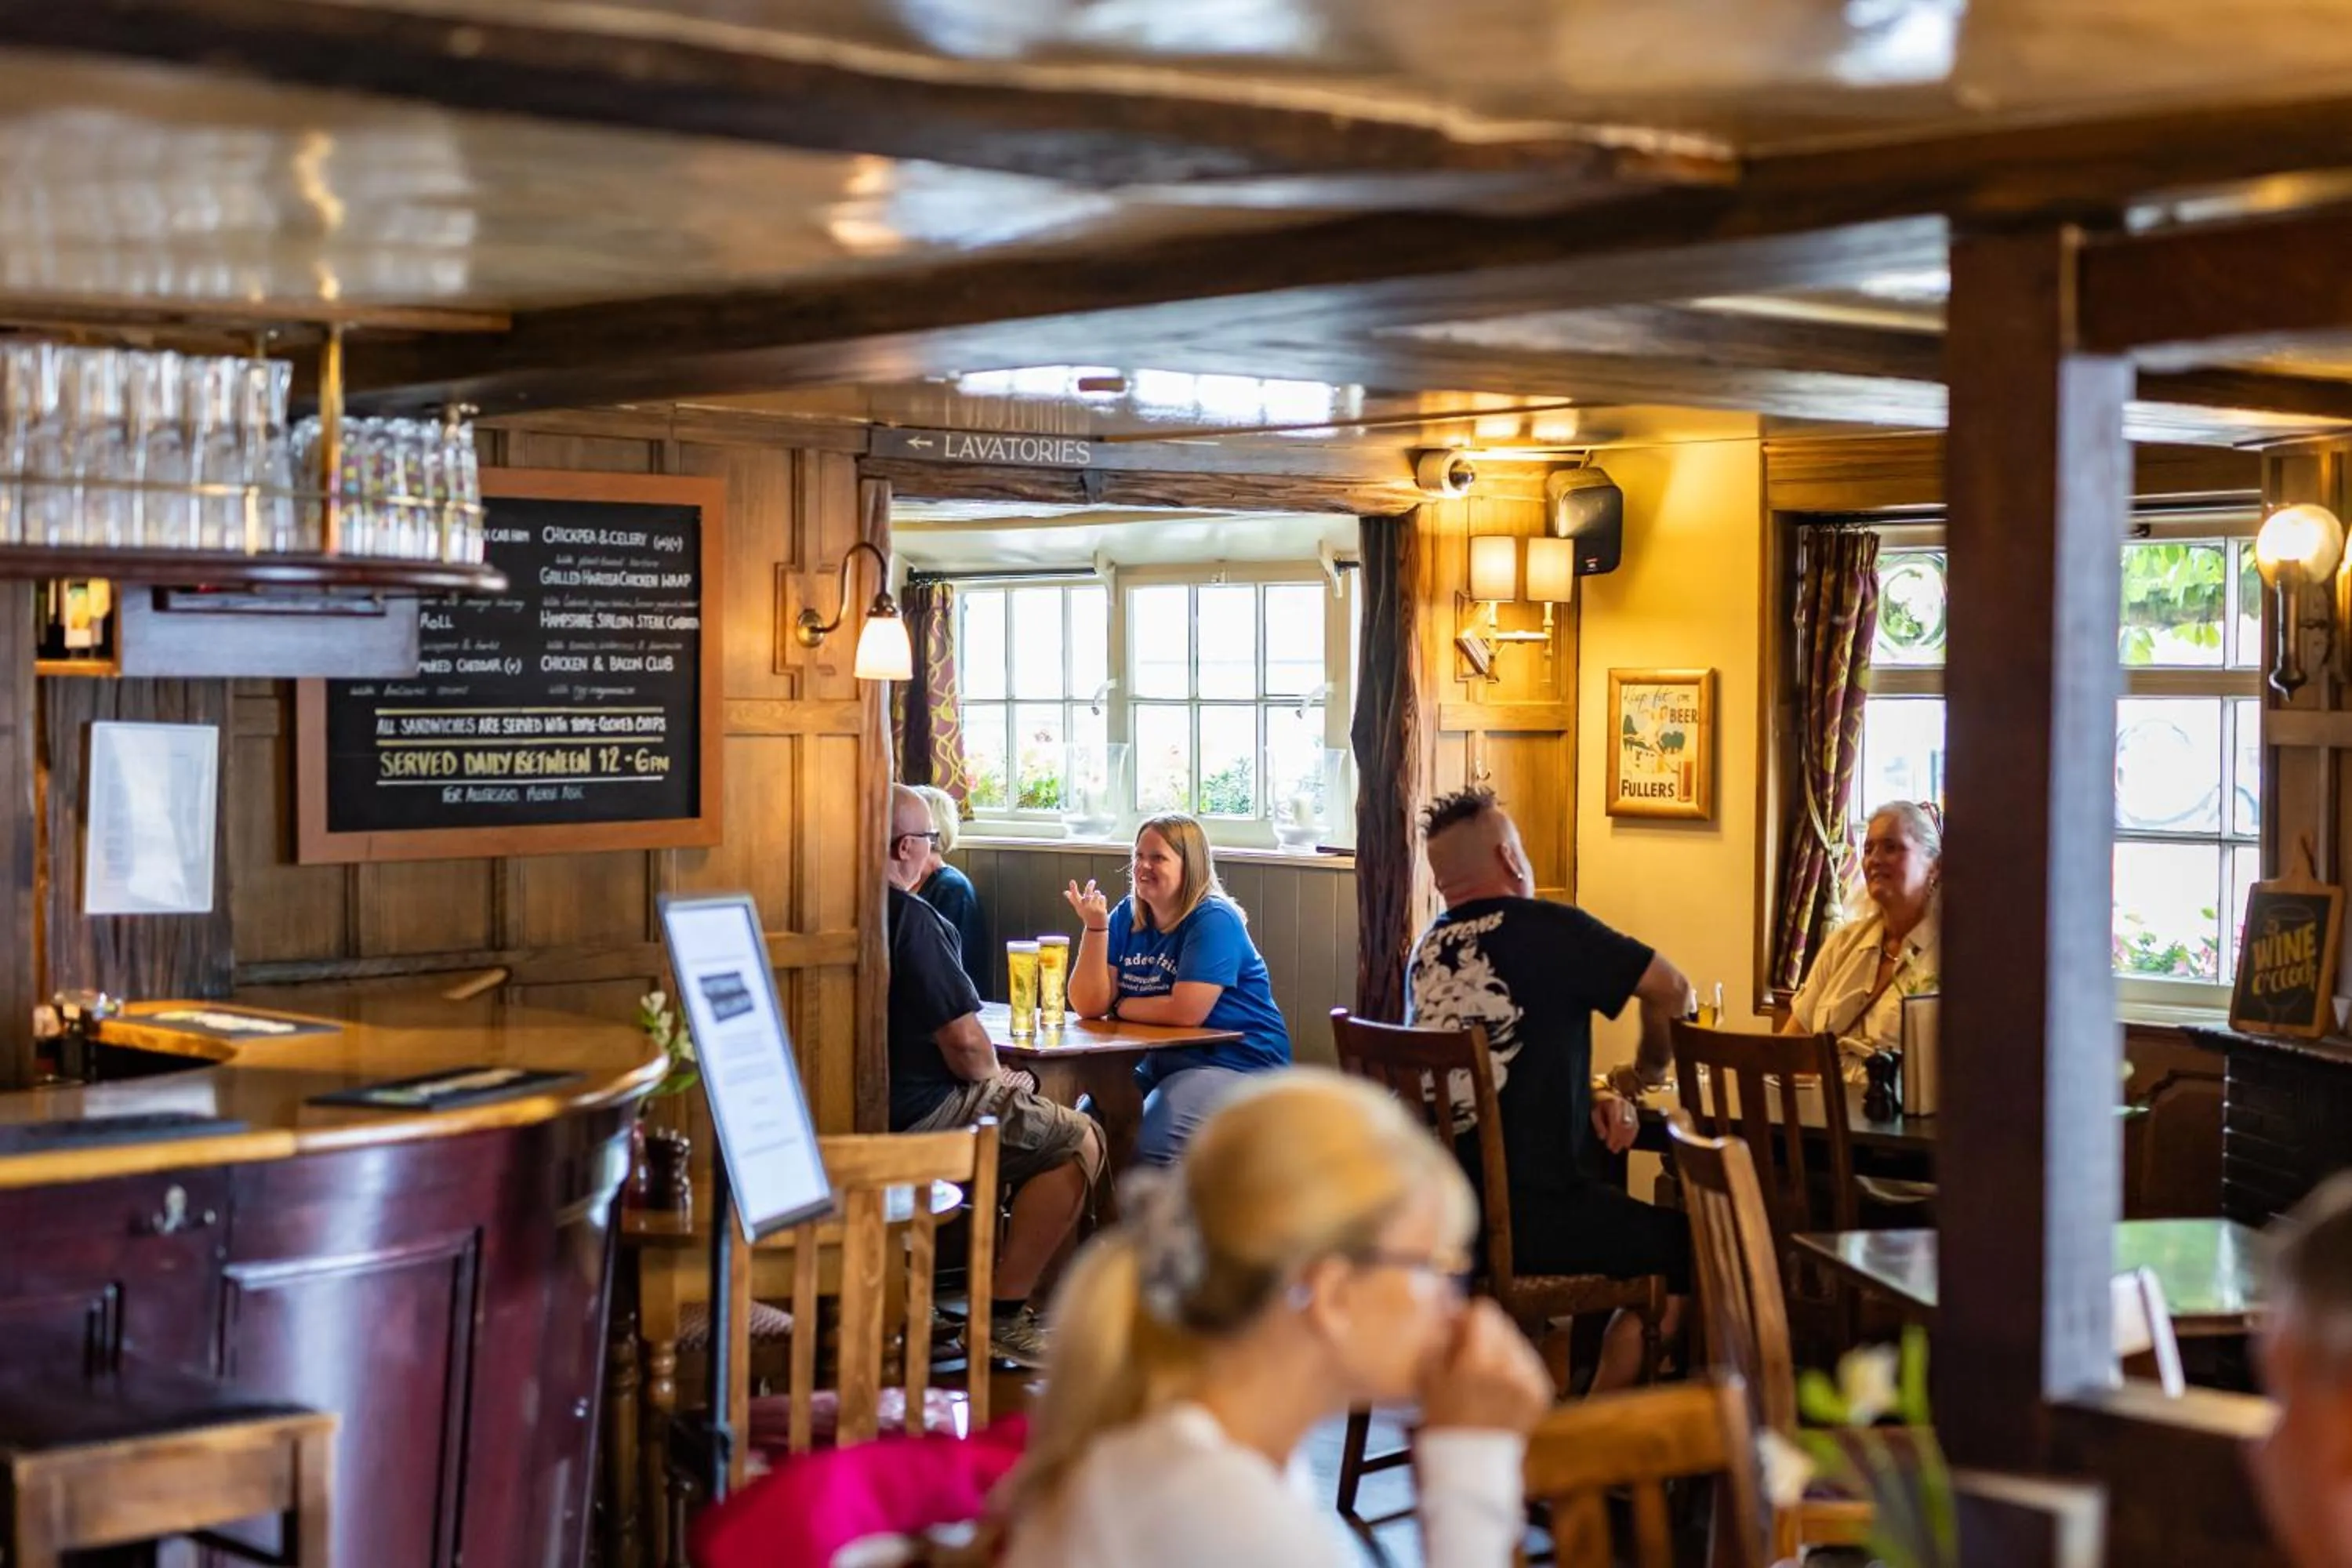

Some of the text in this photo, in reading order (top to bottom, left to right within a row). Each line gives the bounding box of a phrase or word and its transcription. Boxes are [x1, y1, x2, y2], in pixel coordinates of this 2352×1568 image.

[945, 435, 1091, 463] LAVATORIES
[540, 655, 674, 672] CHICKEN & BACON CLUB
[376, 717, 395, 735] ALL
[400, 717, 476, 735] SANDWICHES
[478, 716, 500, 735] ARE
[503, 717, 543, 735] SERVED
[1670, 708, 1698, 724] BEER
[379, 750, 458, 778] SERVED
[463, 750, 513, 775] DAILY
[514, 747, 592, 775] BETWEEN
[1621, 779, 1675, 798] FULLERS
[2252, 922, 2317, 971] WINE
